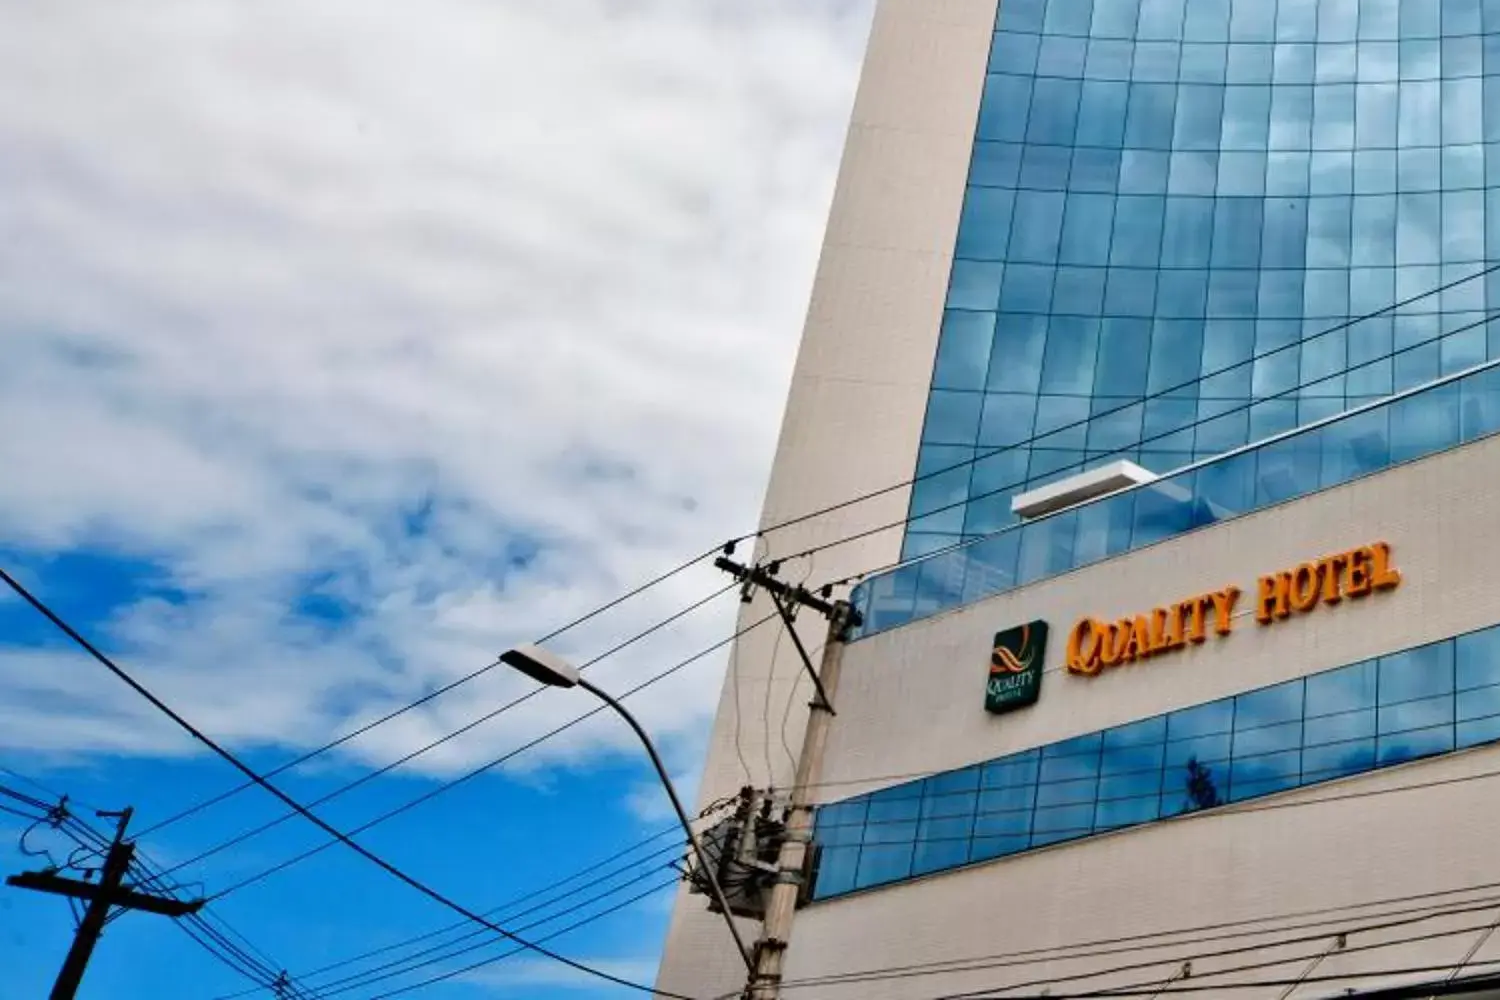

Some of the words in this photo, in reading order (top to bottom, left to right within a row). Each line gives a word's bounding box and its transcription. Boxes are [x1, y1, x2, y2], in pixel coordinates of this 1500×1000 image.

[1066, 586, 1240, 676] QUALITY
[1256, 541, 1400, 625] HOTEL
[987, 669, 1035, 697] QUALITY
